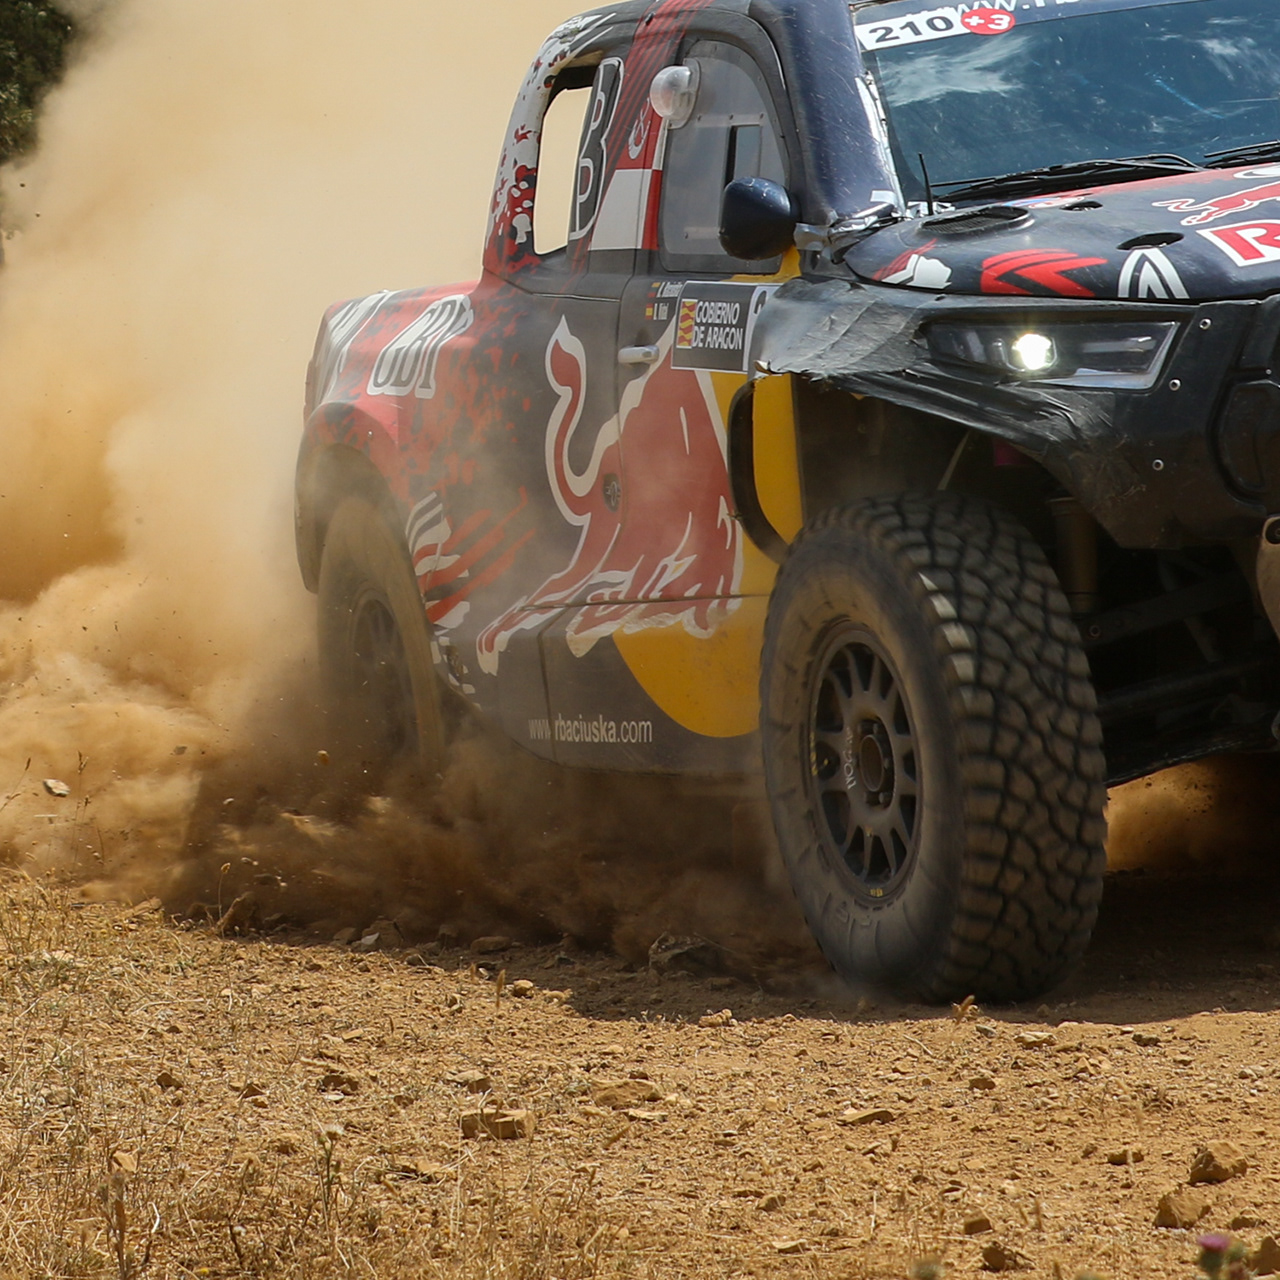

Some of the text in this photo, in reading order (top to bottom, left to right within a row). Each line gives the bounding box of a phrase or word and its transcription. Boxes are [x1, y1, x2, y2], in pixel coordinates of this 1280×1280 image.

[868, 16, 954, 44] 210
[695, 301, 740, 325] GOBIERNO
[692, 326, 744, 350] DE ARAGON
[528, 713, 652, 743] wwwrbaciuska.com
